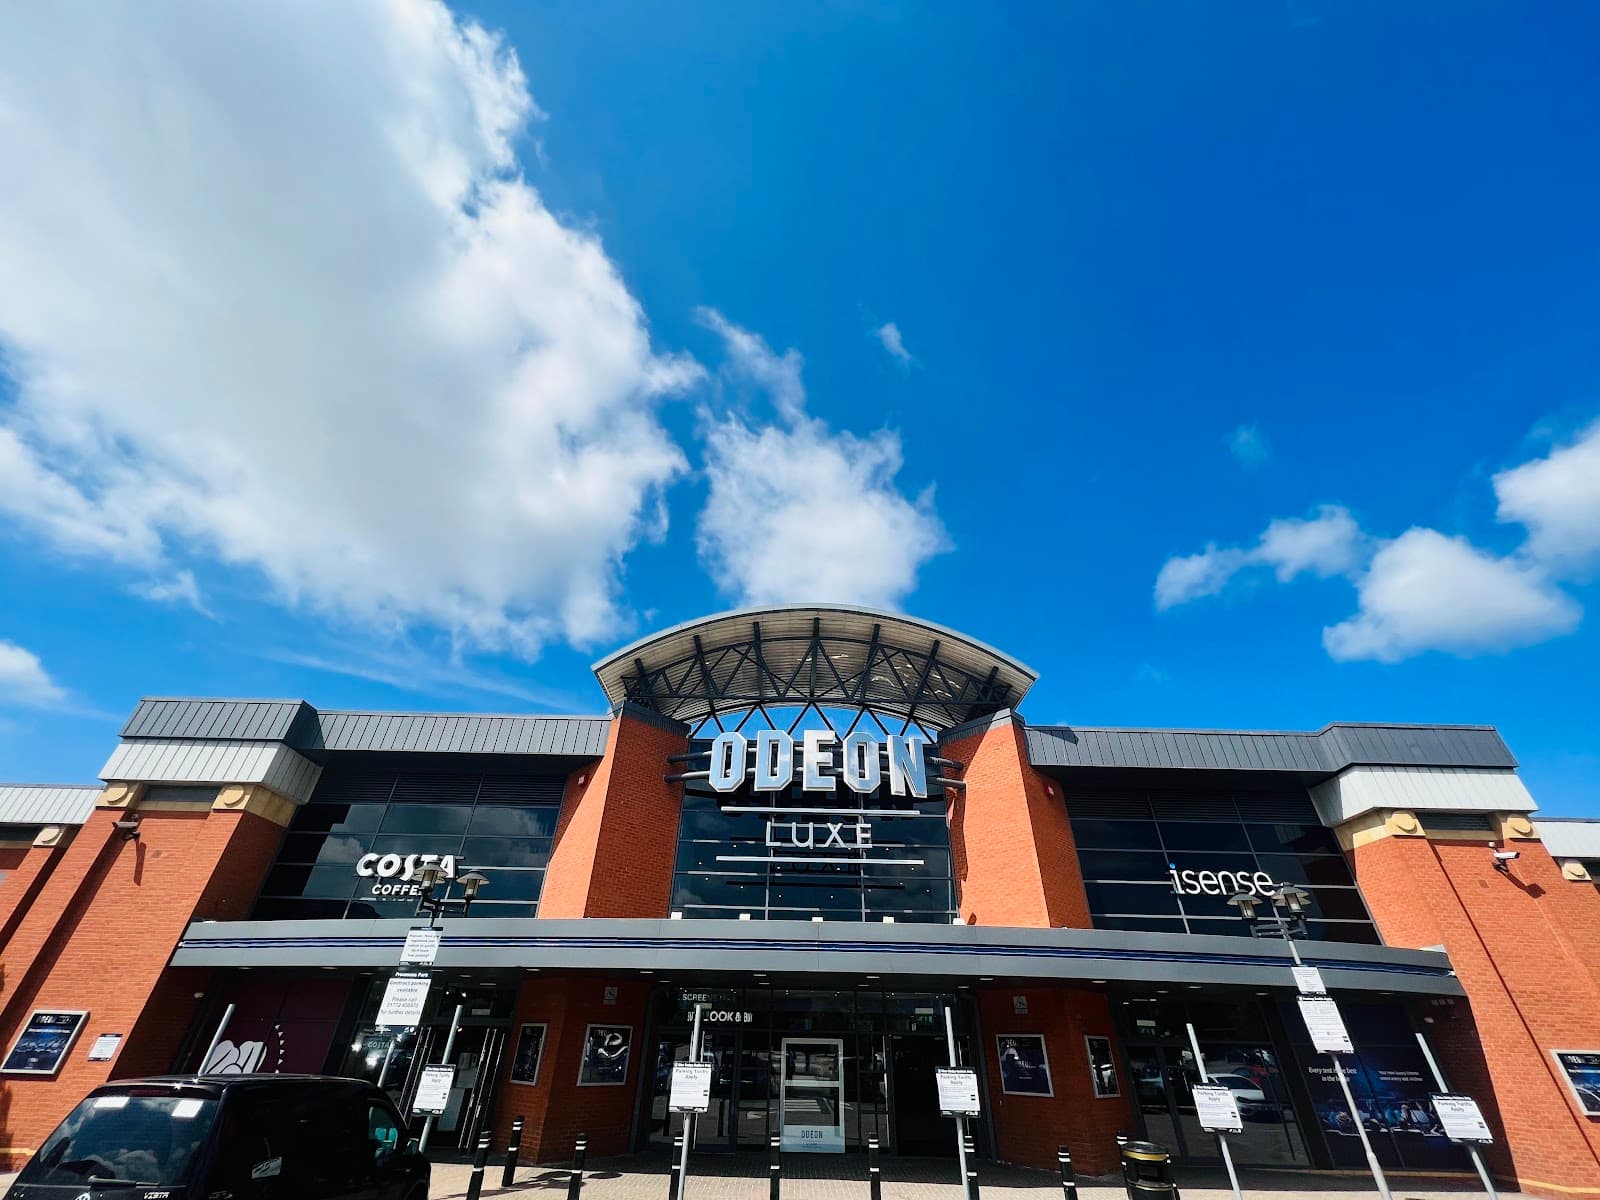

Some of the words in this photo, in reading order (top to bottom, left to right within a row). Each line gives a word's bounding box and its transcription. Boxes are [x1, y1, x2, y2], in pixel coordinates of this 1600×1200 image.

[709, 730, 928, 798] ODEON
[765, 821, 873, 849] LUXE
[356, 853, 456, 881] COSTA
[1169, 863, 1276, 896] isense
[371, 884, 422, 896] COFFE
